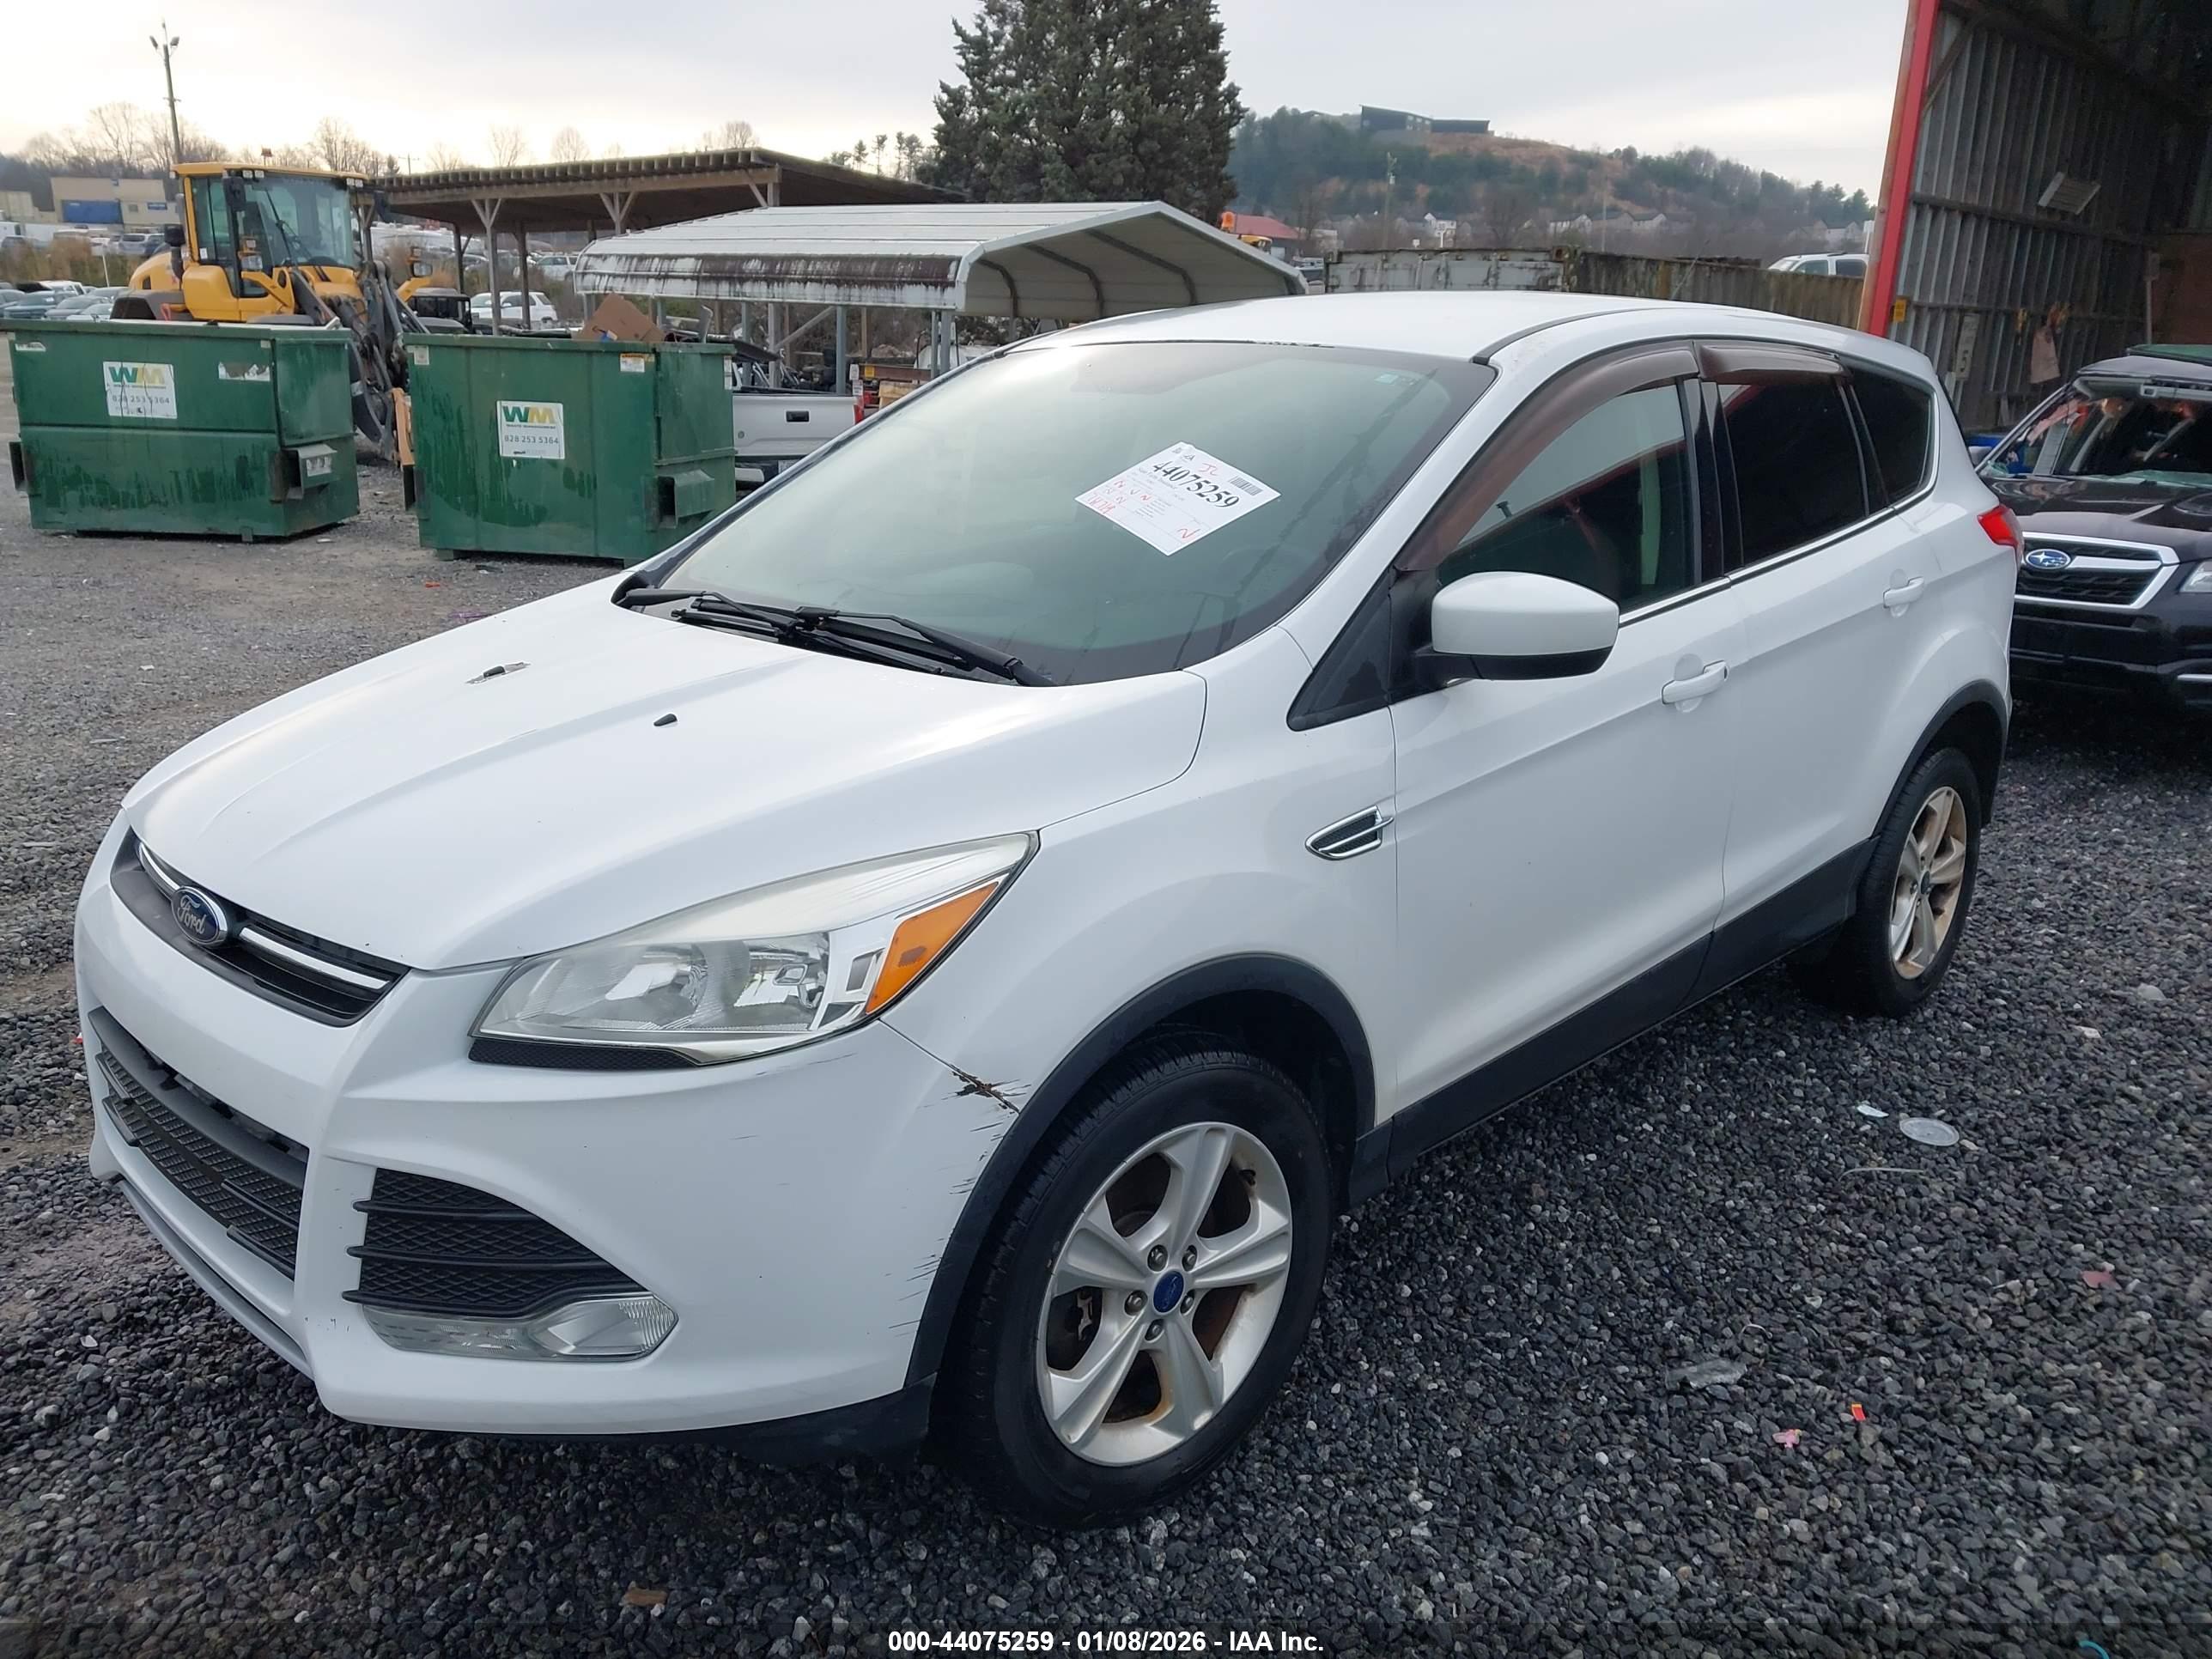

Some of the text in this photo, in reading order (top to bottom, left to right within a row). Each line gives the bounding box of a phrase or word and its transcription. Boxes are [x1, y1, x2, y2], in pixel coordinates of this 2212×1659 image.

[108, 366, 166, 384] WM
[502, 405, 556, 424] WM
[521, 434, 536, 444] 253
[1152, 460, 1241, 510] 44075259
[177, 894, 207, 935] Ford
